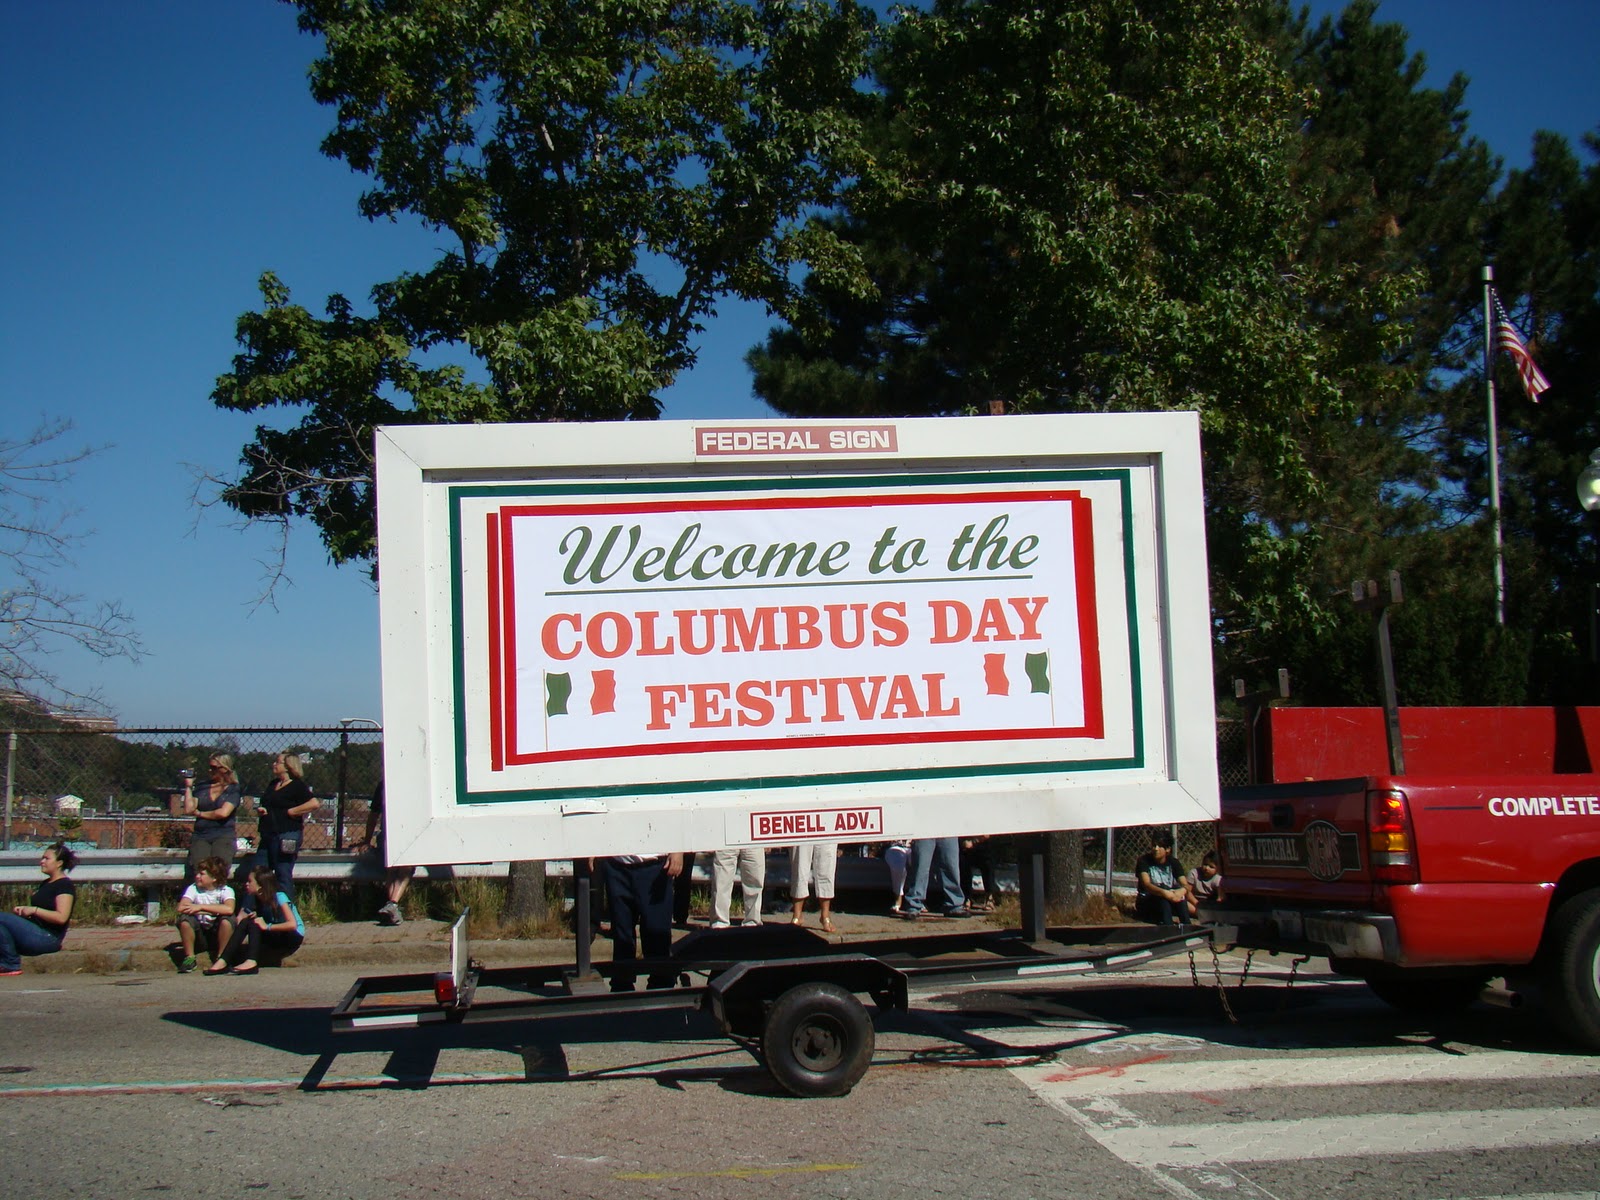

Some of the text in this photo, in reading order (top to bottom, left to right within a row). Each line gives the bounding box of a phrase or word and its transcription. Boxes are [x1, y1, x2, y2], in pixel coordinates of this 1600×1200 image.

[702, 430, 890, 451] FEDERAL SIGN
[558, 513, 1040, 585] Welcome to the
[541, 596, 1049, 661] COLUMBUS DAY
[645, 672, 961, 731] FESTIVAL
[1488, 796, 1600, 817] COMPLETE
[759, 811, 875, 835] BENELL ADV.
[1256, 838, 1300, 862] FEDERAL
